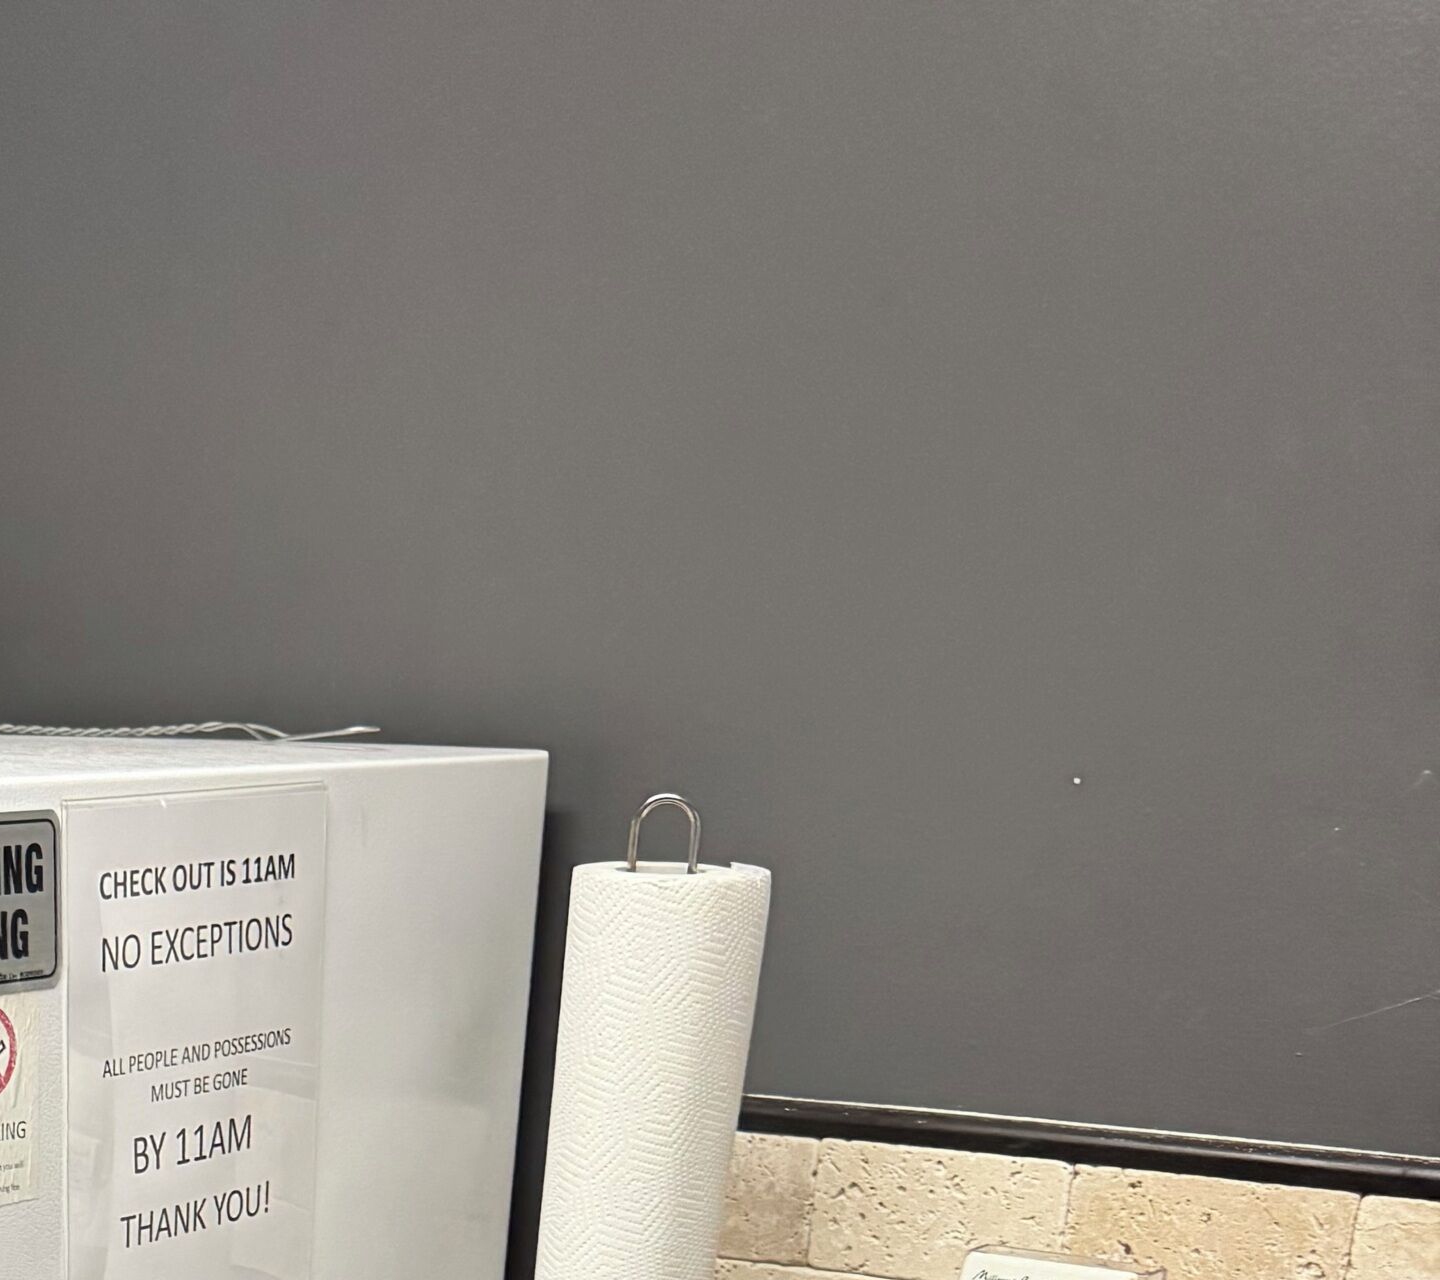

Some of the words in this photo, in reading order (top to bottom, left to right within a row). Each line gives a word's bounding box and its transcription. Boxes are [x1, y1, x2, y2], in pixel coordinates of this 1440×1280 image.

[100, 866, 167, 900] CHECK
[172, 861, 215, 892] OUT
[220, 859, 236, 888] IS
[241, 853, 296, 884] 11AM
[101, 933, 141, 972] NO
[151, 913, 293, 965] EXCEPTIONS
[102, 1059, 126, 1079] ALL
[129, 1048, 178, 1074] PEOPLE
[181, 1042, 211, 1065] AND
[214, 1027, 292, 1059] POSSESSIONS
[151, 1078, 191, 1103] MUST
[194, 1075, 210, 1095] BE
[213, 1068, 248, 1091] GONE
[133, 1131, 167, 1175] BY
[176, 1114, 252, 1166] 11AM
[120, 1198, 207, 1249] THANK
[213, 1180, 270, 1226] YOU!
